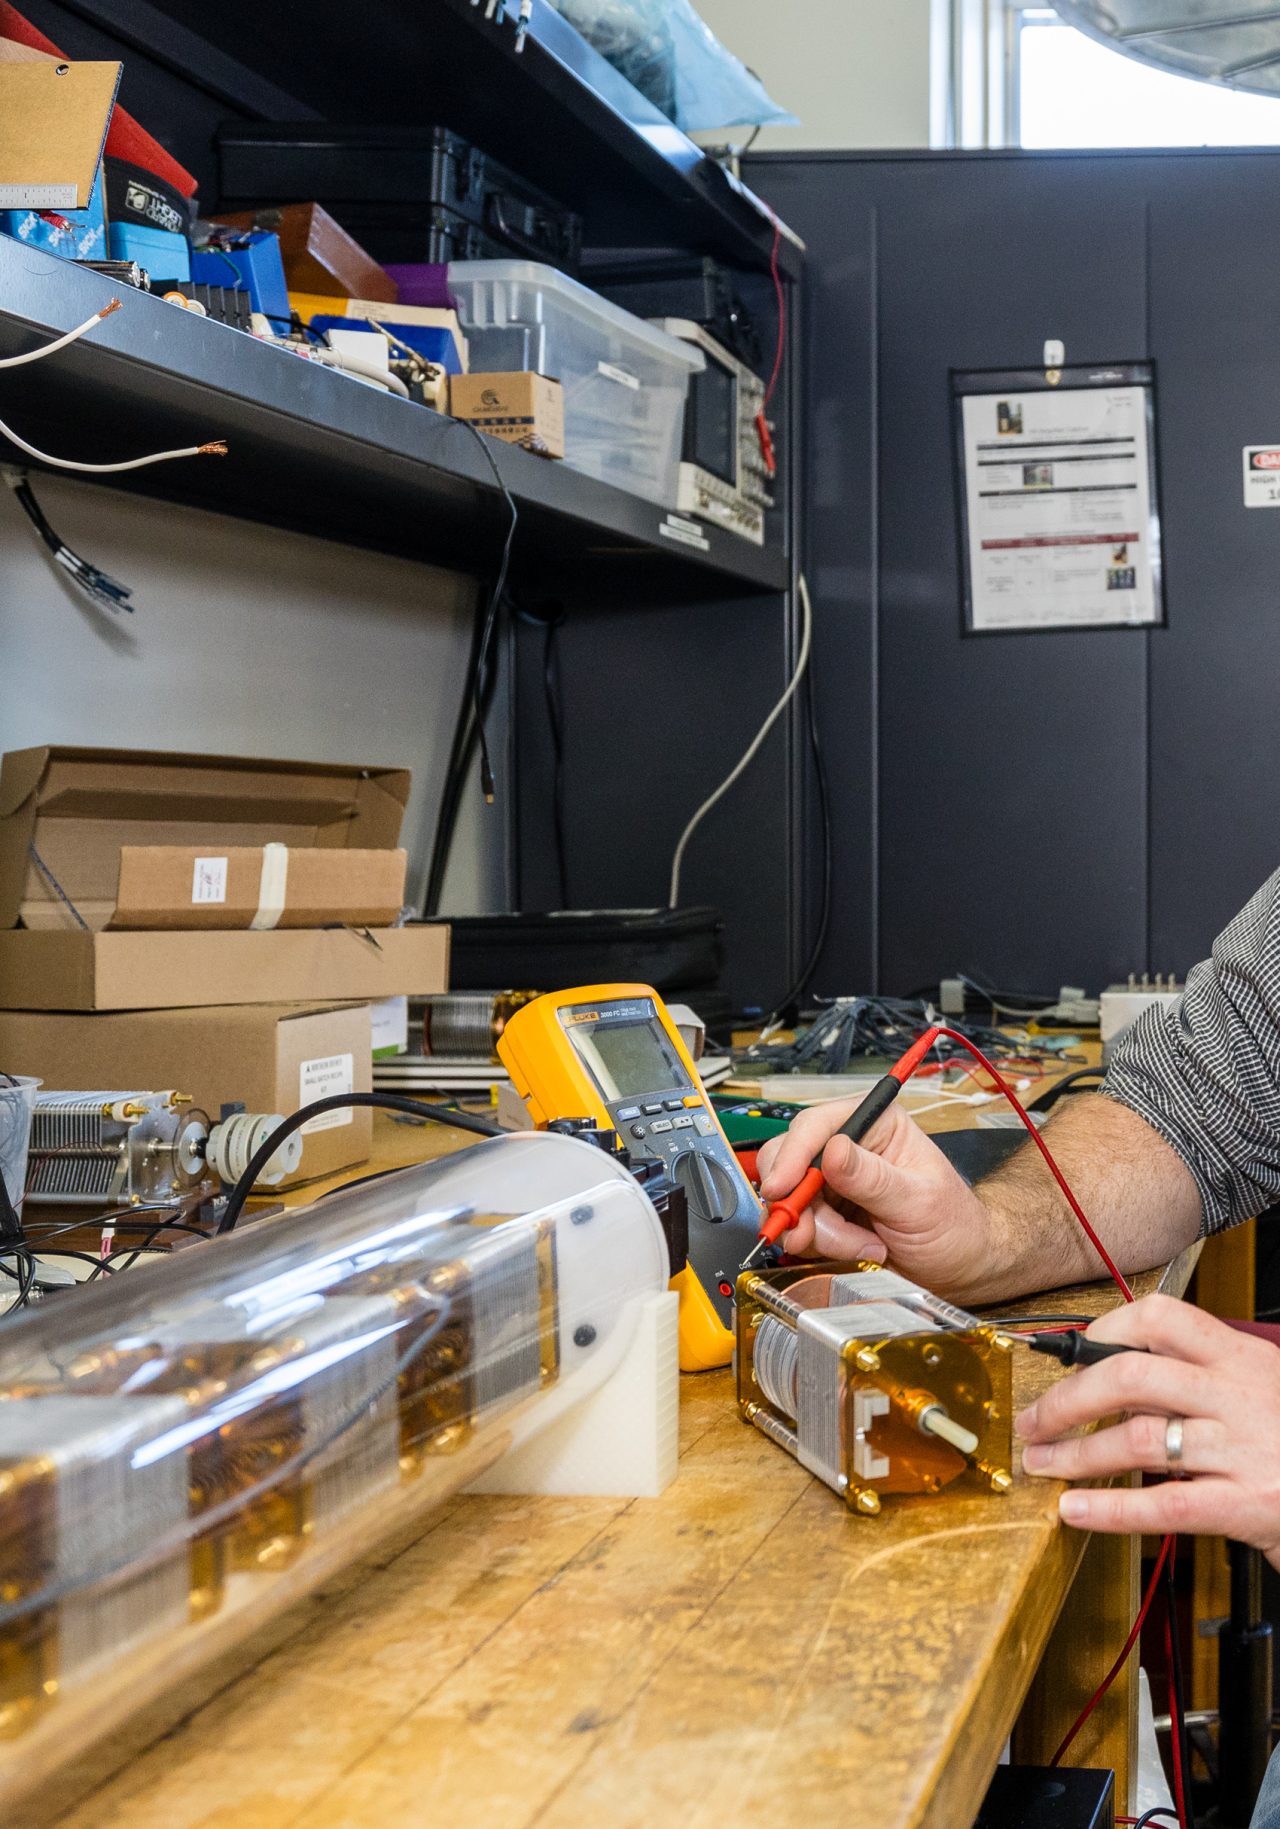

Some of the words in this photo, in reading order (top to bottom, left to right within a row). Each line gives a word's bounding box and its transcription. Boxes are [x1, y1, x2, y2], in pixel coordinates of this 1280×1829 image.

[18, 212, 38, 239] SICK
[78, 228, 97, 255] SICK
[1251, 474, 1276, 483] HIGH
[568, 1012, 597, 1022] FLUKE
